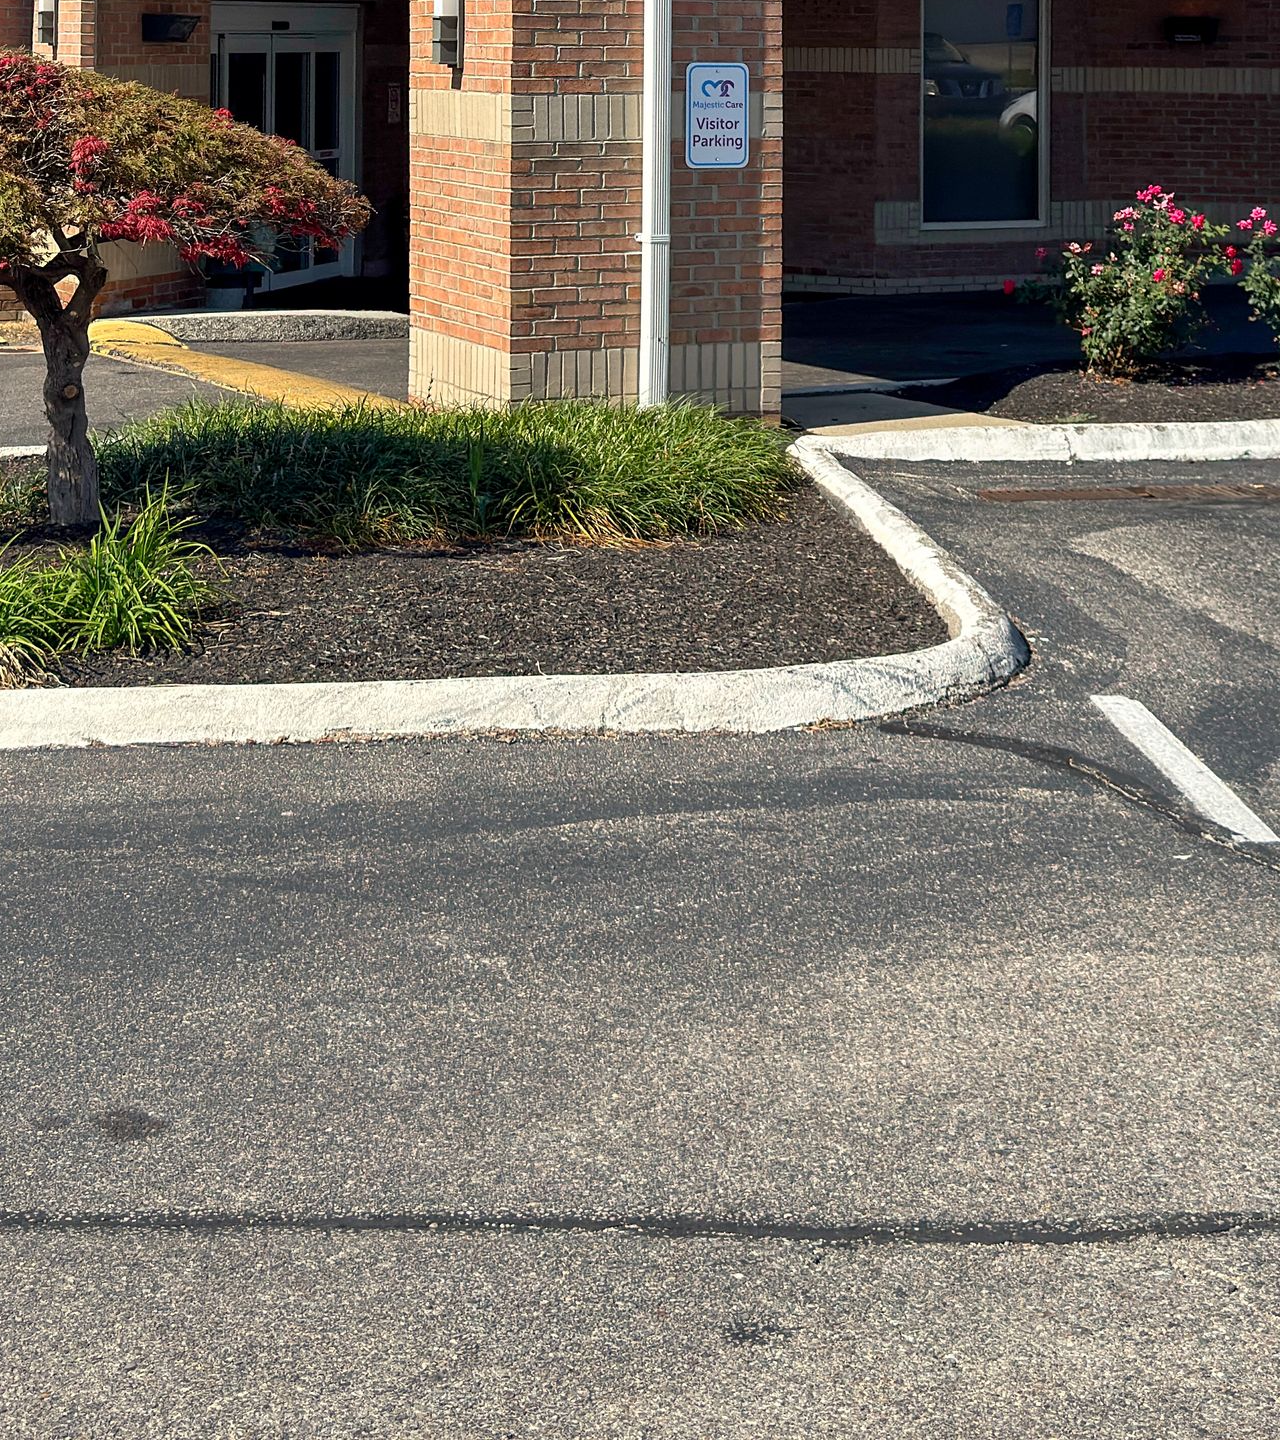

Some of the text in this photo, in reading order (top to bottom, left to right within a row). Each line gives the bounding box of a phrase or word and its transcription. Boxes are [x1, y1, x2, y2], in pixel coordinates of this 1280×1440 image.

[692, 101, 744, 110] Majestic Care
[696, 117, 740, 130] Visitor
[692, 134, 743, 150] Parking
